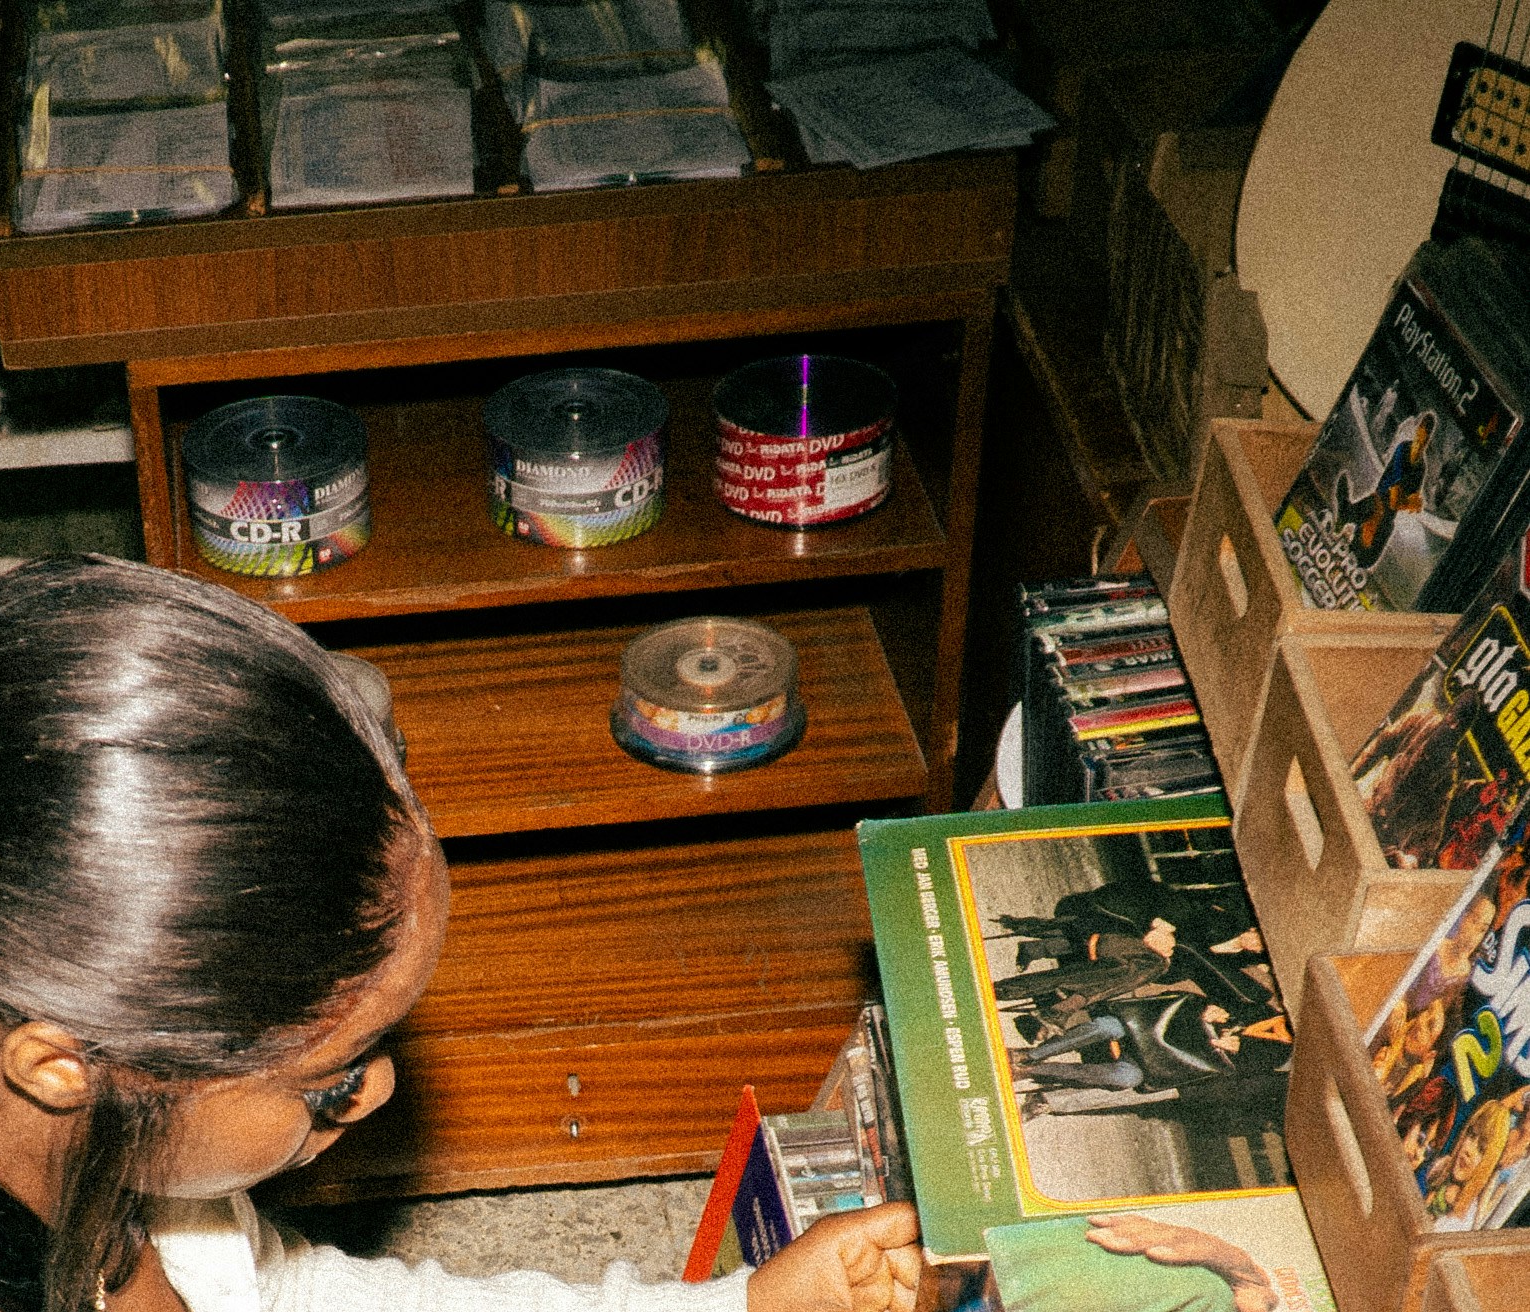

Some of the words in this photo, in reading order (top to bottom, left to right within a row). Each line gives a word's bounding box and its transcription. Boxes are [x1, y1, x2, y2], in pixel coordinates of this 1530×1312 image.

[809, 433, 845, 455] DVD
[742, 466, 776, 481] DVD
[229, 520, 302, 544] CD-R
[1282, 527, 1337, 610] SOCCER
[1331, 541, 1368, 590] PRO
[915, 872, 934, 890] JAN
[920, 890, 941, 929] BERGER
[928, 935, 947, 958] ERIK
[933, 959, 958, 1019] AMUNDSEN
[945, 1027, 966, 1064] ESPEN
[1451, 1008, 1503, 1102] 2
[952, 1064, 971, 1090] RUD
